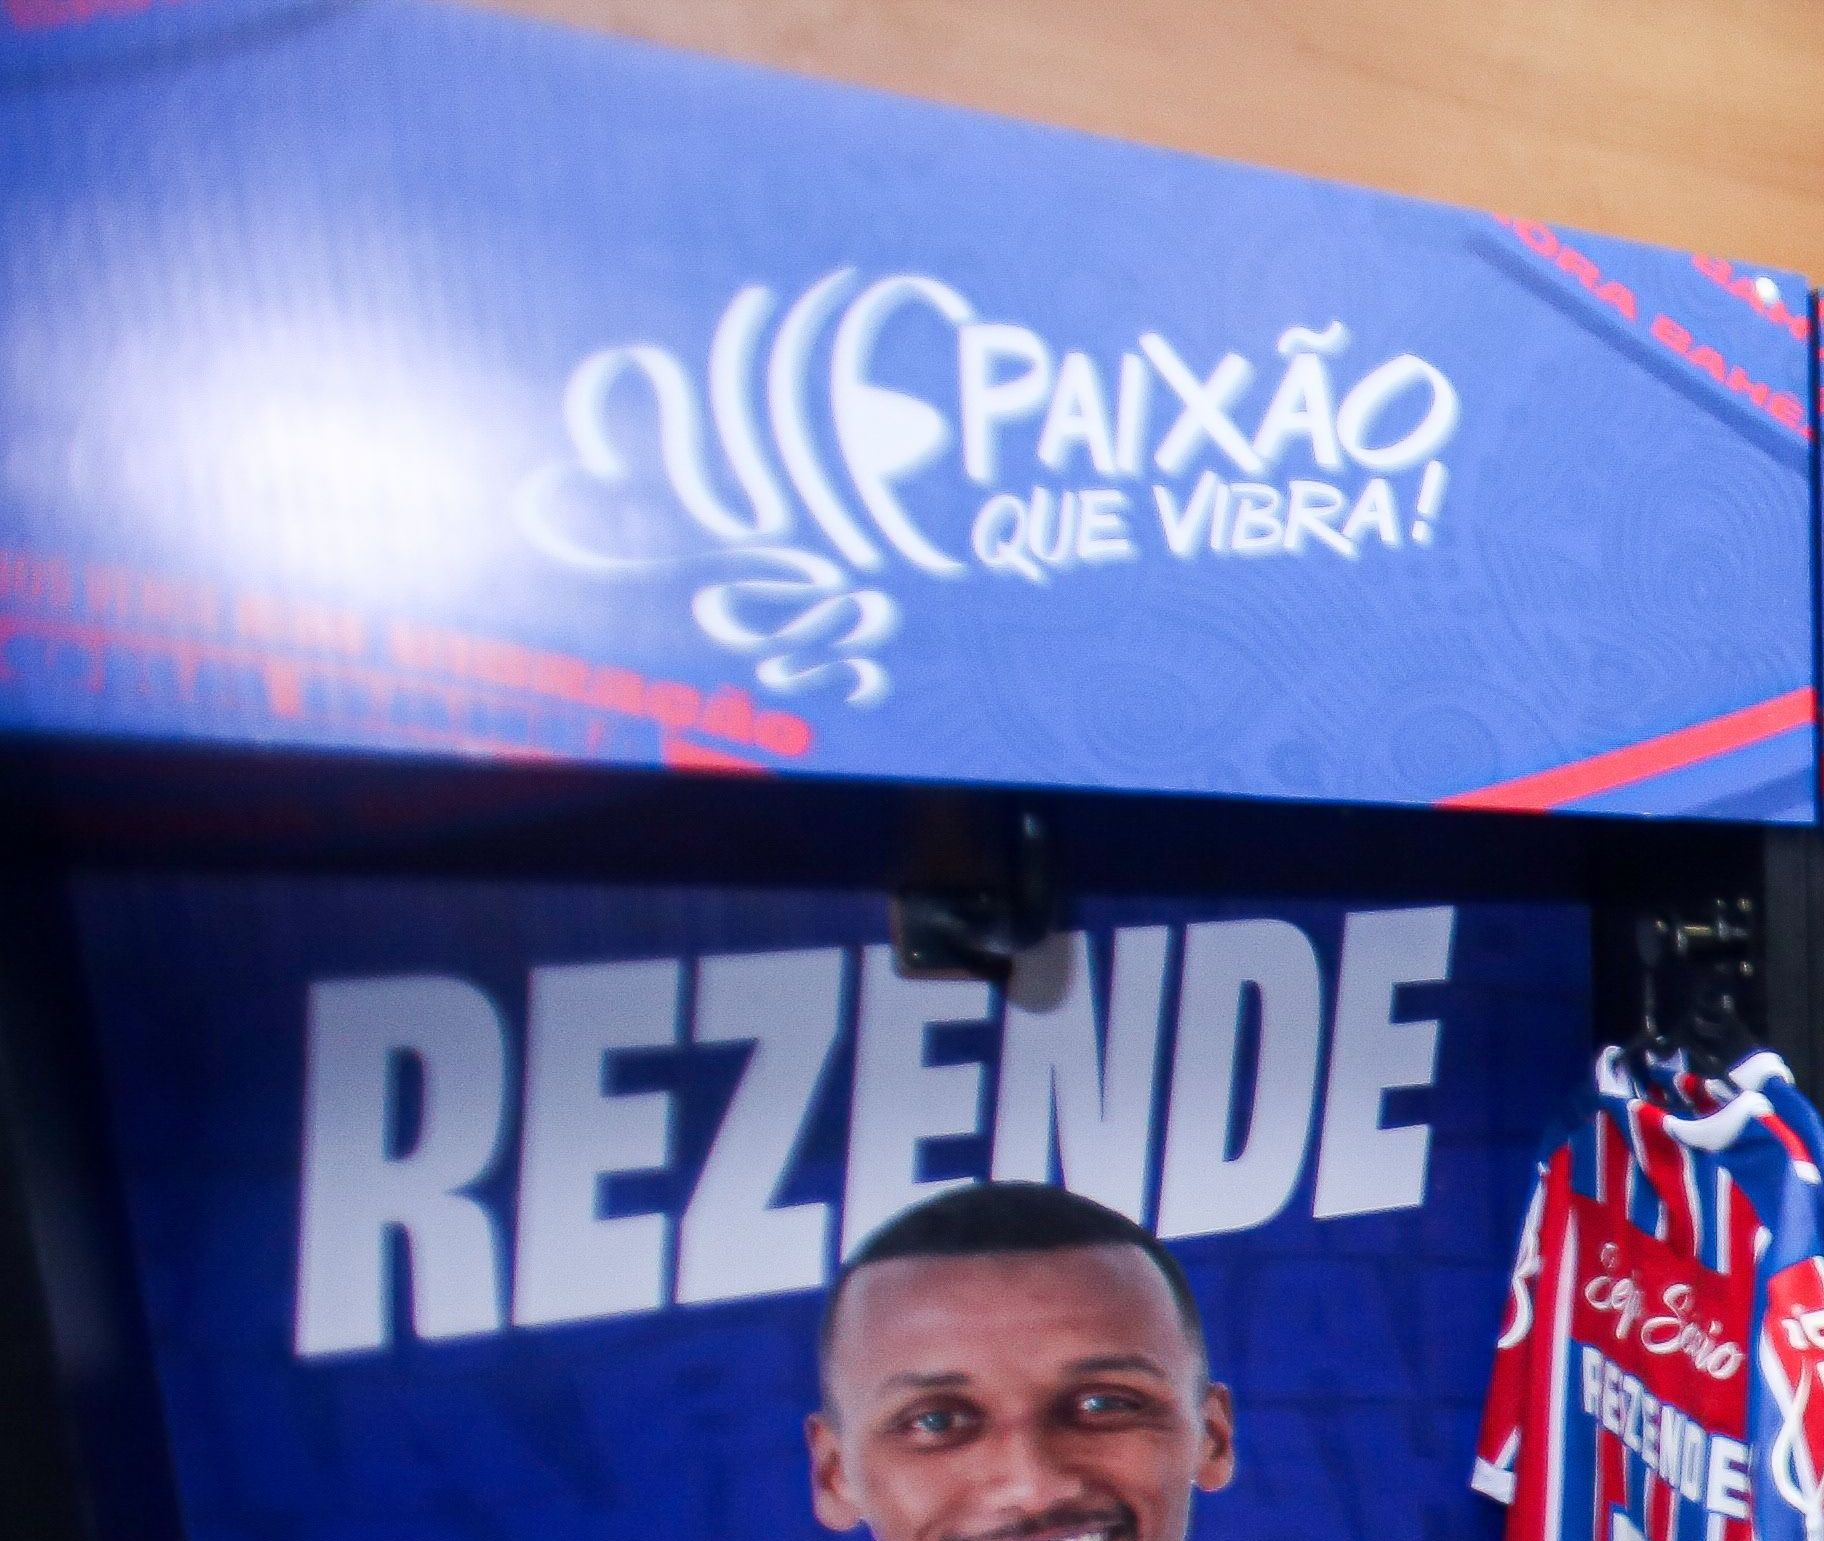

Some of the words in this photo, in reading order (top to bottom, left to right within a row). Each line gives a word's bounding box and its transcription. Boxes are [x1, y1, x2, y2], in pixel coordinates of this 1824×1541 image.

[958, 320, 1460, 484] PAIXÃO
[972, 484, 1136, 584] QUE
[1154, 458, 1450, 560] VIBRA!
[294, 905, 1457, 1360] REZENDE
